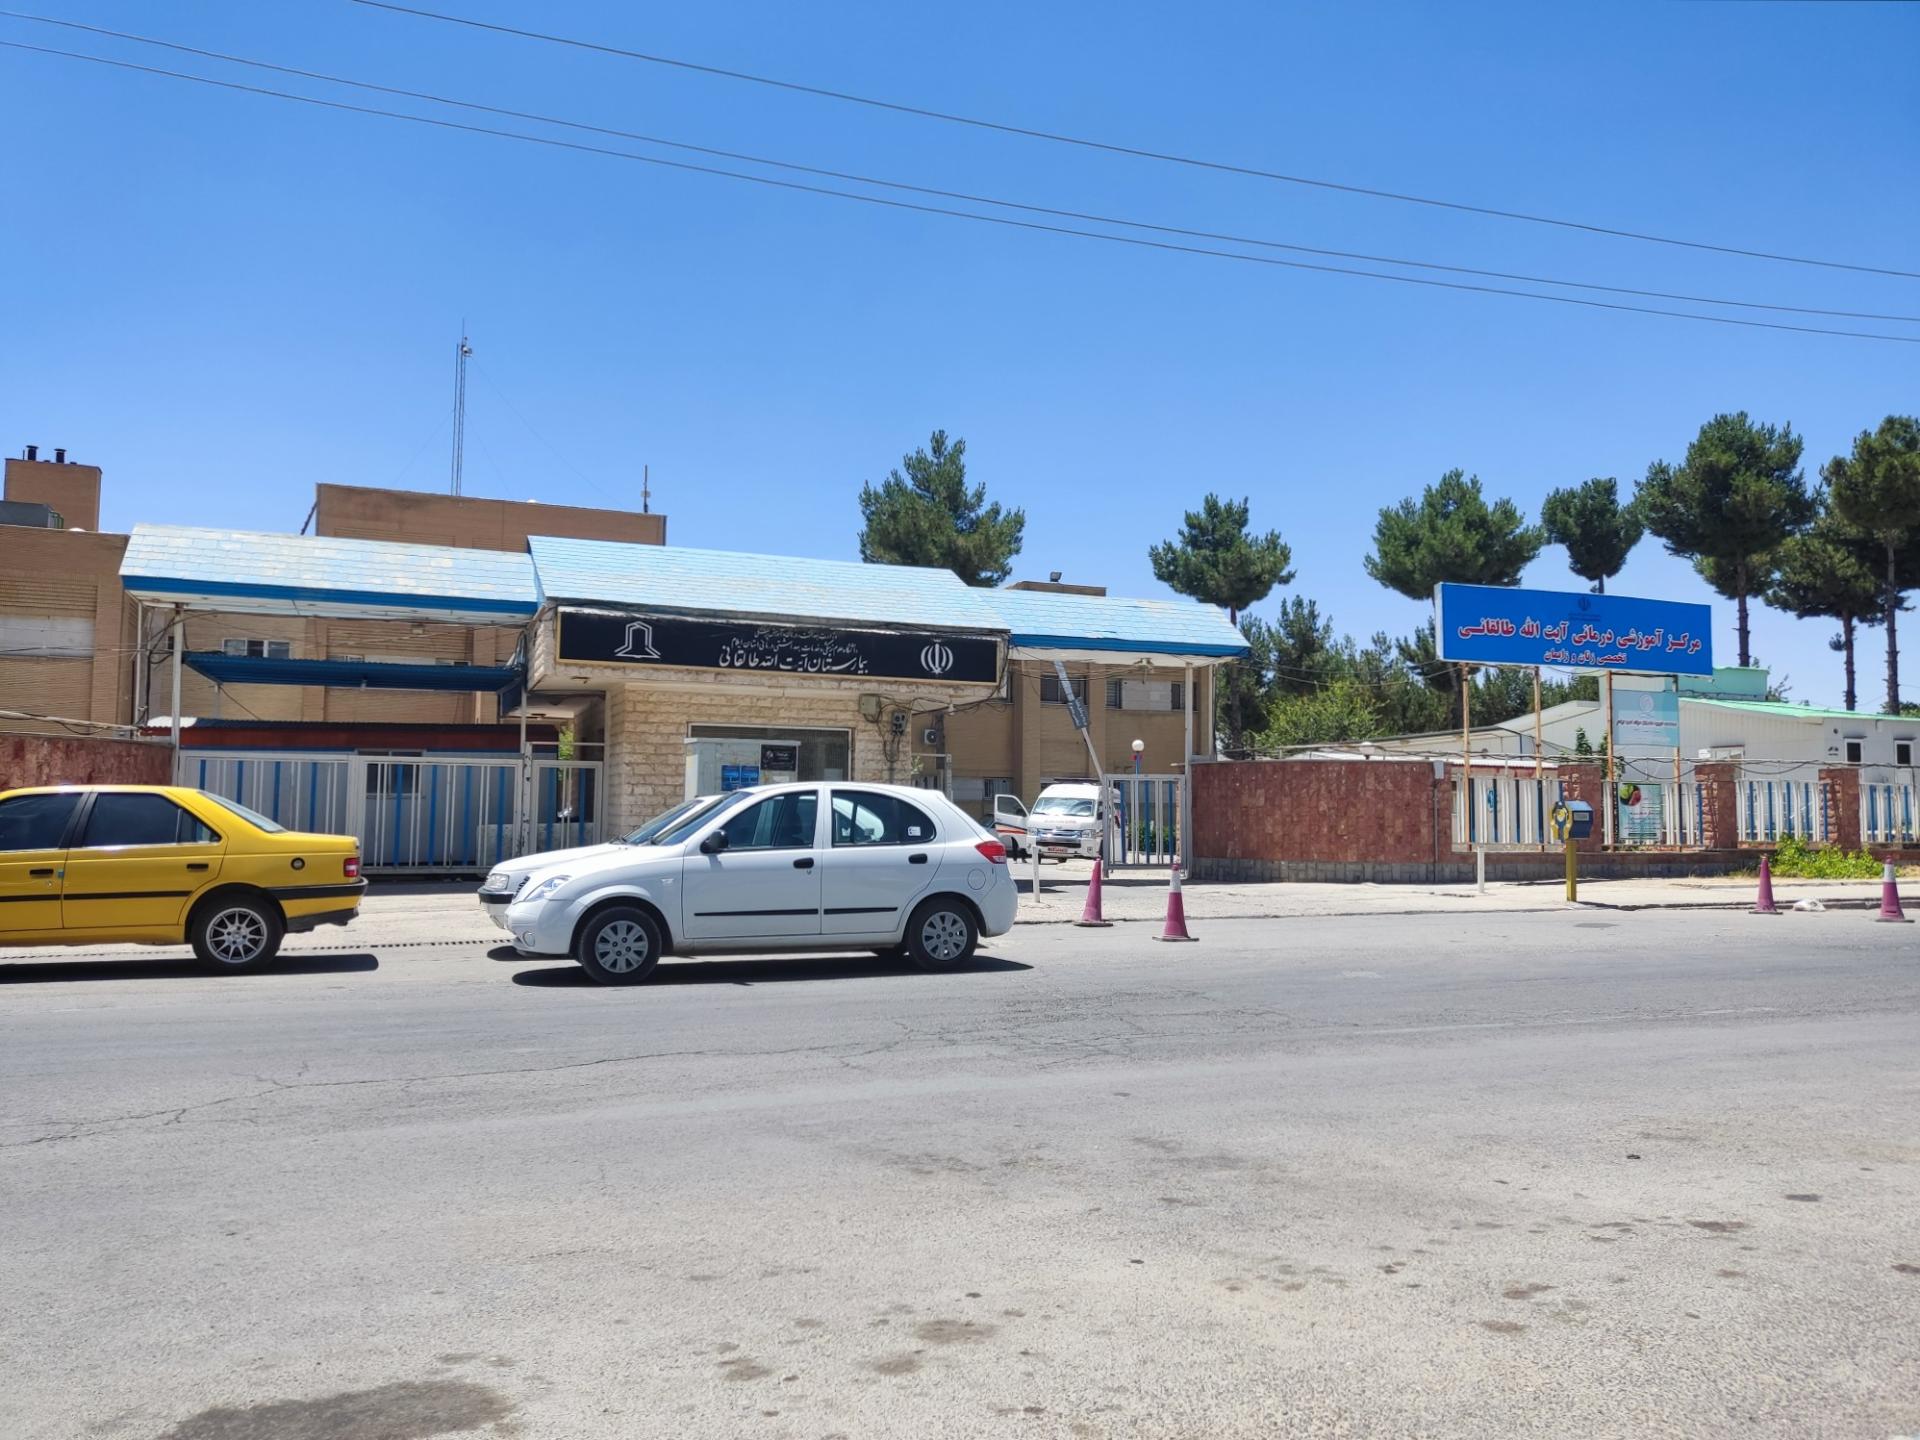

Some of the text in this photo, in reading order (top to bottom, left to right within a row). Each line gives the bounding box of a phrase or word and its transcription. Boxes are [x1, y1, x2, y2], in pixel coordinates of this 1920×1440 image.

[1457, 616, 1702, 655] مرکز آموزشی درمانی آیت الله طالقانی
[718, 645, 869, 675] بیمارستان آیت الله طالقانی
[1543, 648, 1628, 665] تخصصی زنان و زایمان
